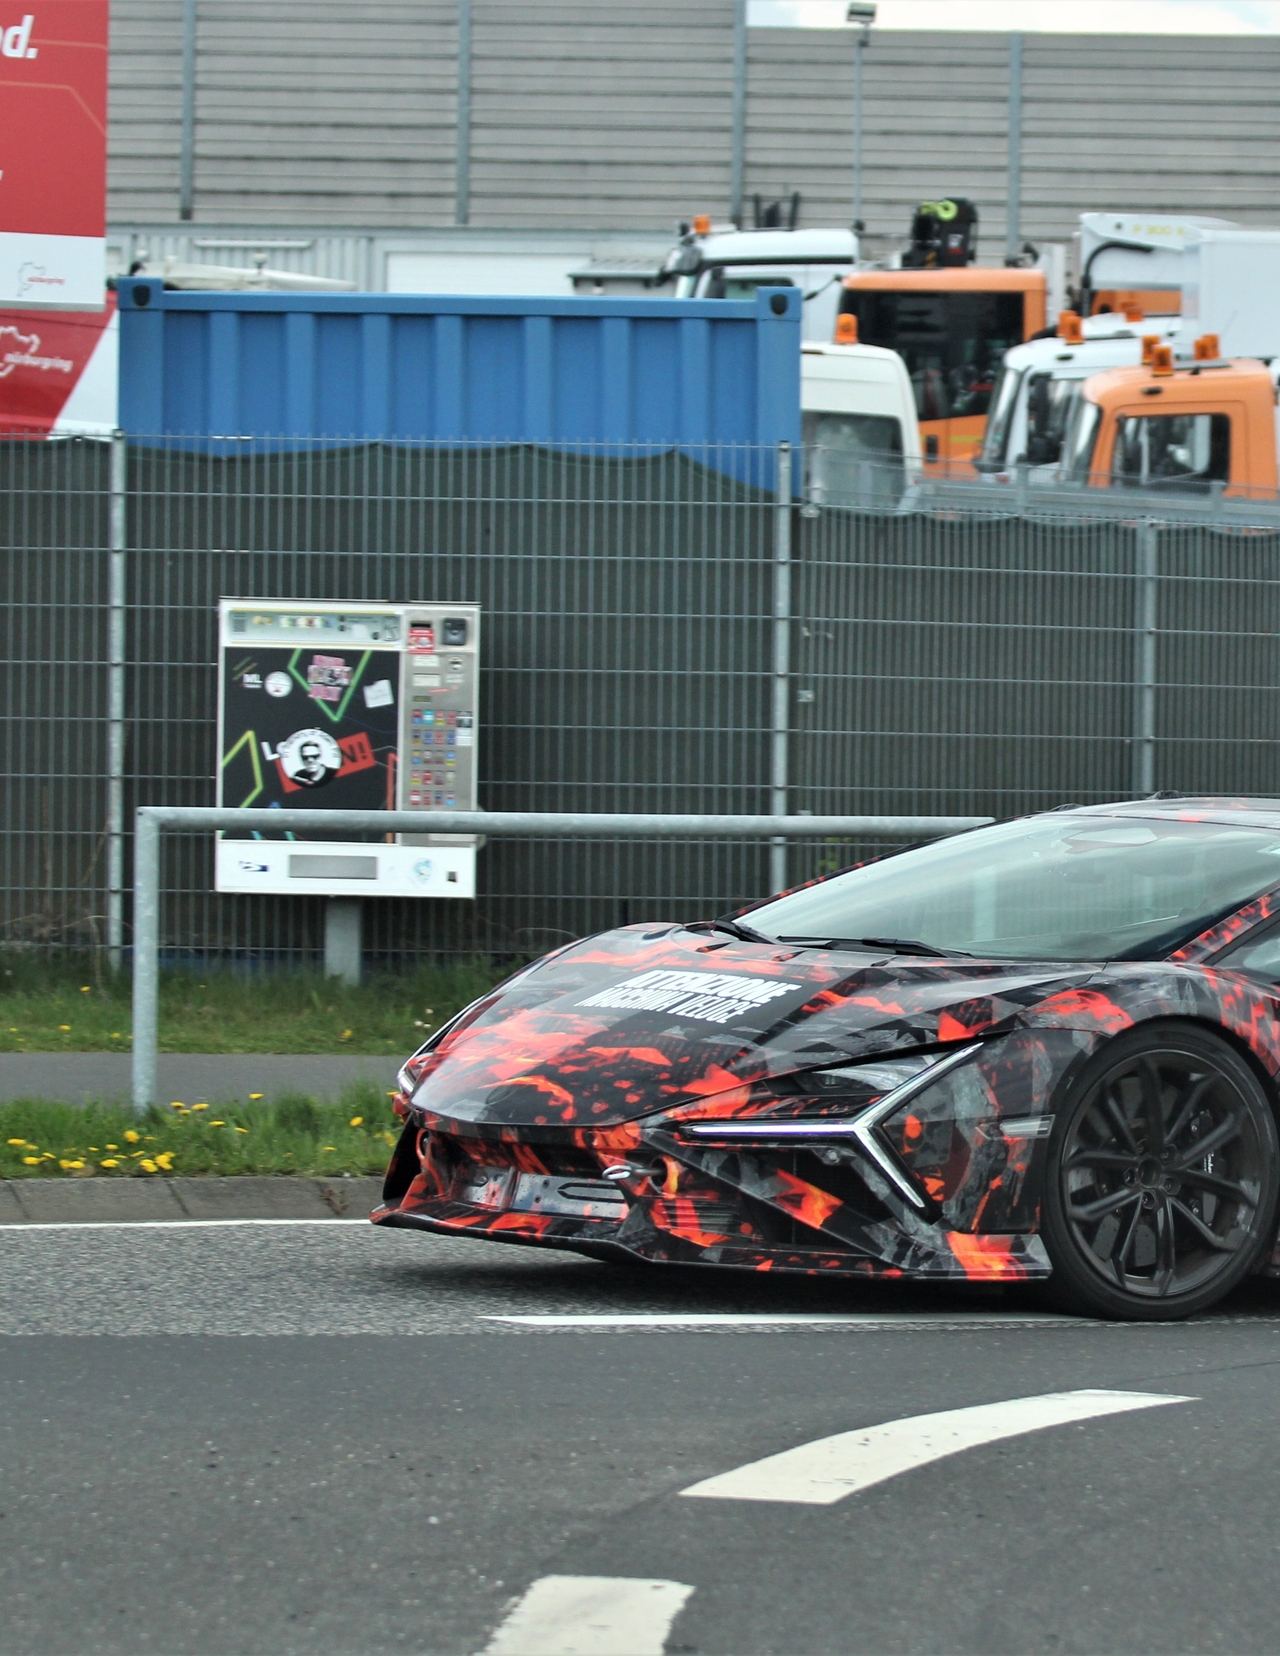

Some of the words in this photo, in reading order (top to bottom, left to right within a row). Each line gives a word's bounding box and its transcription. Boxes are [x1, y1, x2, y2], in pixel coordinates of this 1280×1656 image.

[614, 969, 802, 1004] ATTENZIONE
[574, 987, 696, 1013] MACCHINA
[666, 993, 761, 1024] VELOCE
